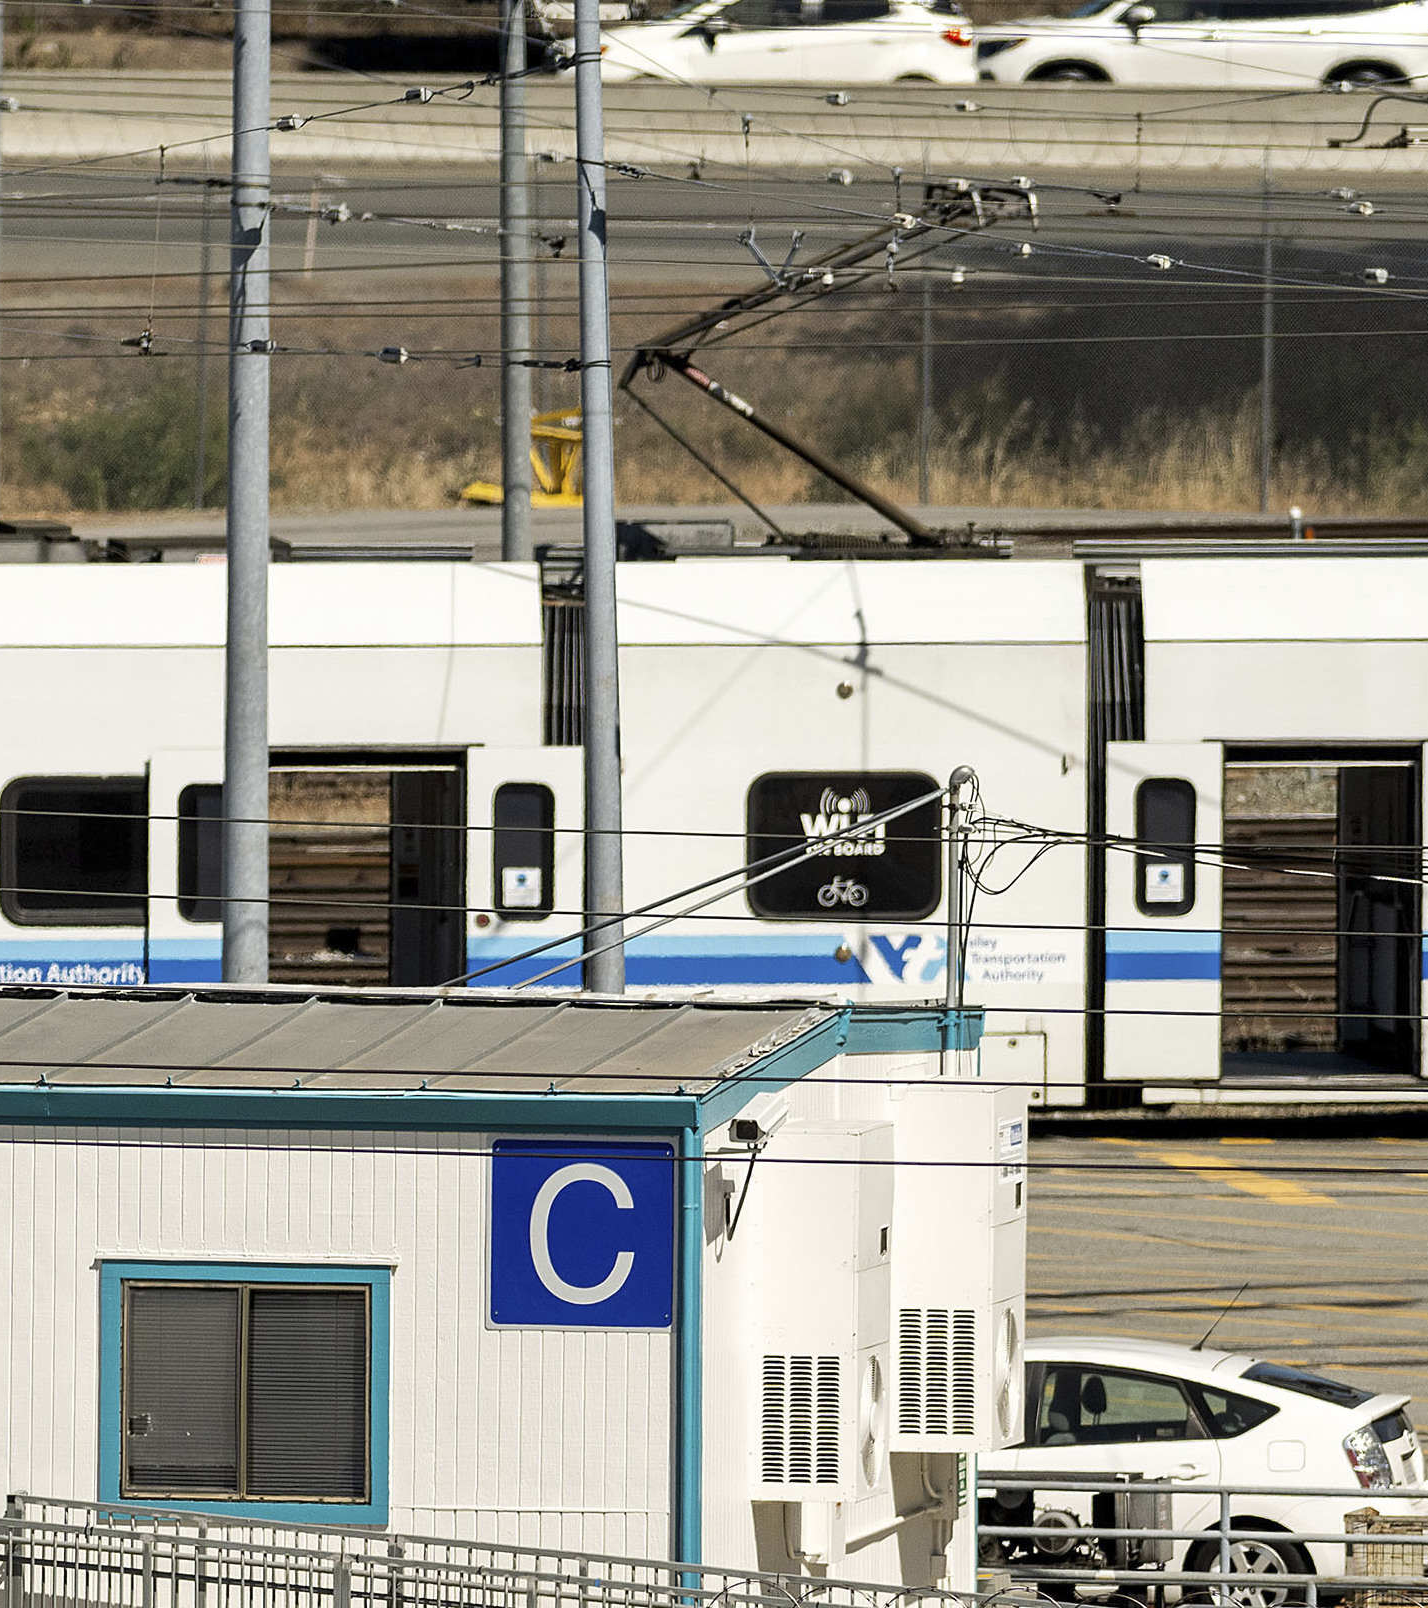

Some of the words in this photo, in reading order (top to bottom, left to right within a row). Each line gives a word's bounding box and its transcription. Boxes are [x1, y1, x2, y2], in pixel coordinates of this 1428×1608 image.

[971, 953, 1066, 967] Transportation
[46, 962, 145, 985] Authority
[982, 970, 1044, 984] Authority
[529, 1162, 635, 1305] C
